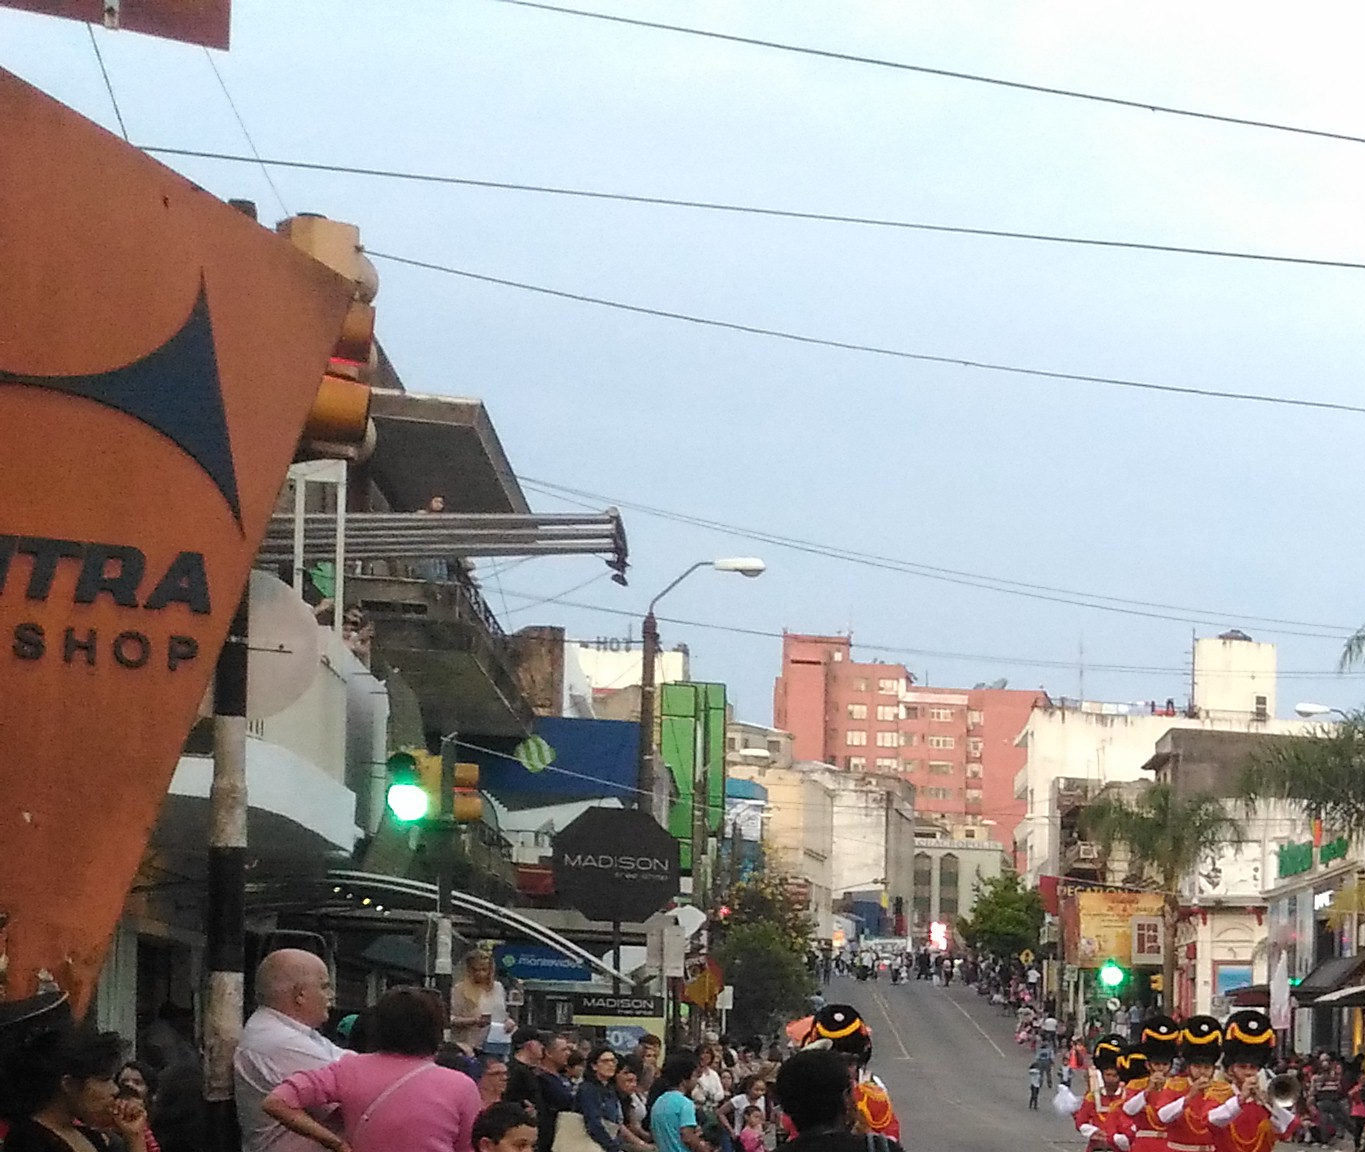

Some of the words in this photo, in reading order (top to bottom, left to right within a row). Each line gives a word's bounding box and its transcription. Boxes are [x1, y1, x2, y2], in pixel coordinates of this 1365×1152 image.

[12, 622, 199, 671] SHOP
[564, 854, 669, 872] MADISON
[583, 998, 655, 1010] MADISON
